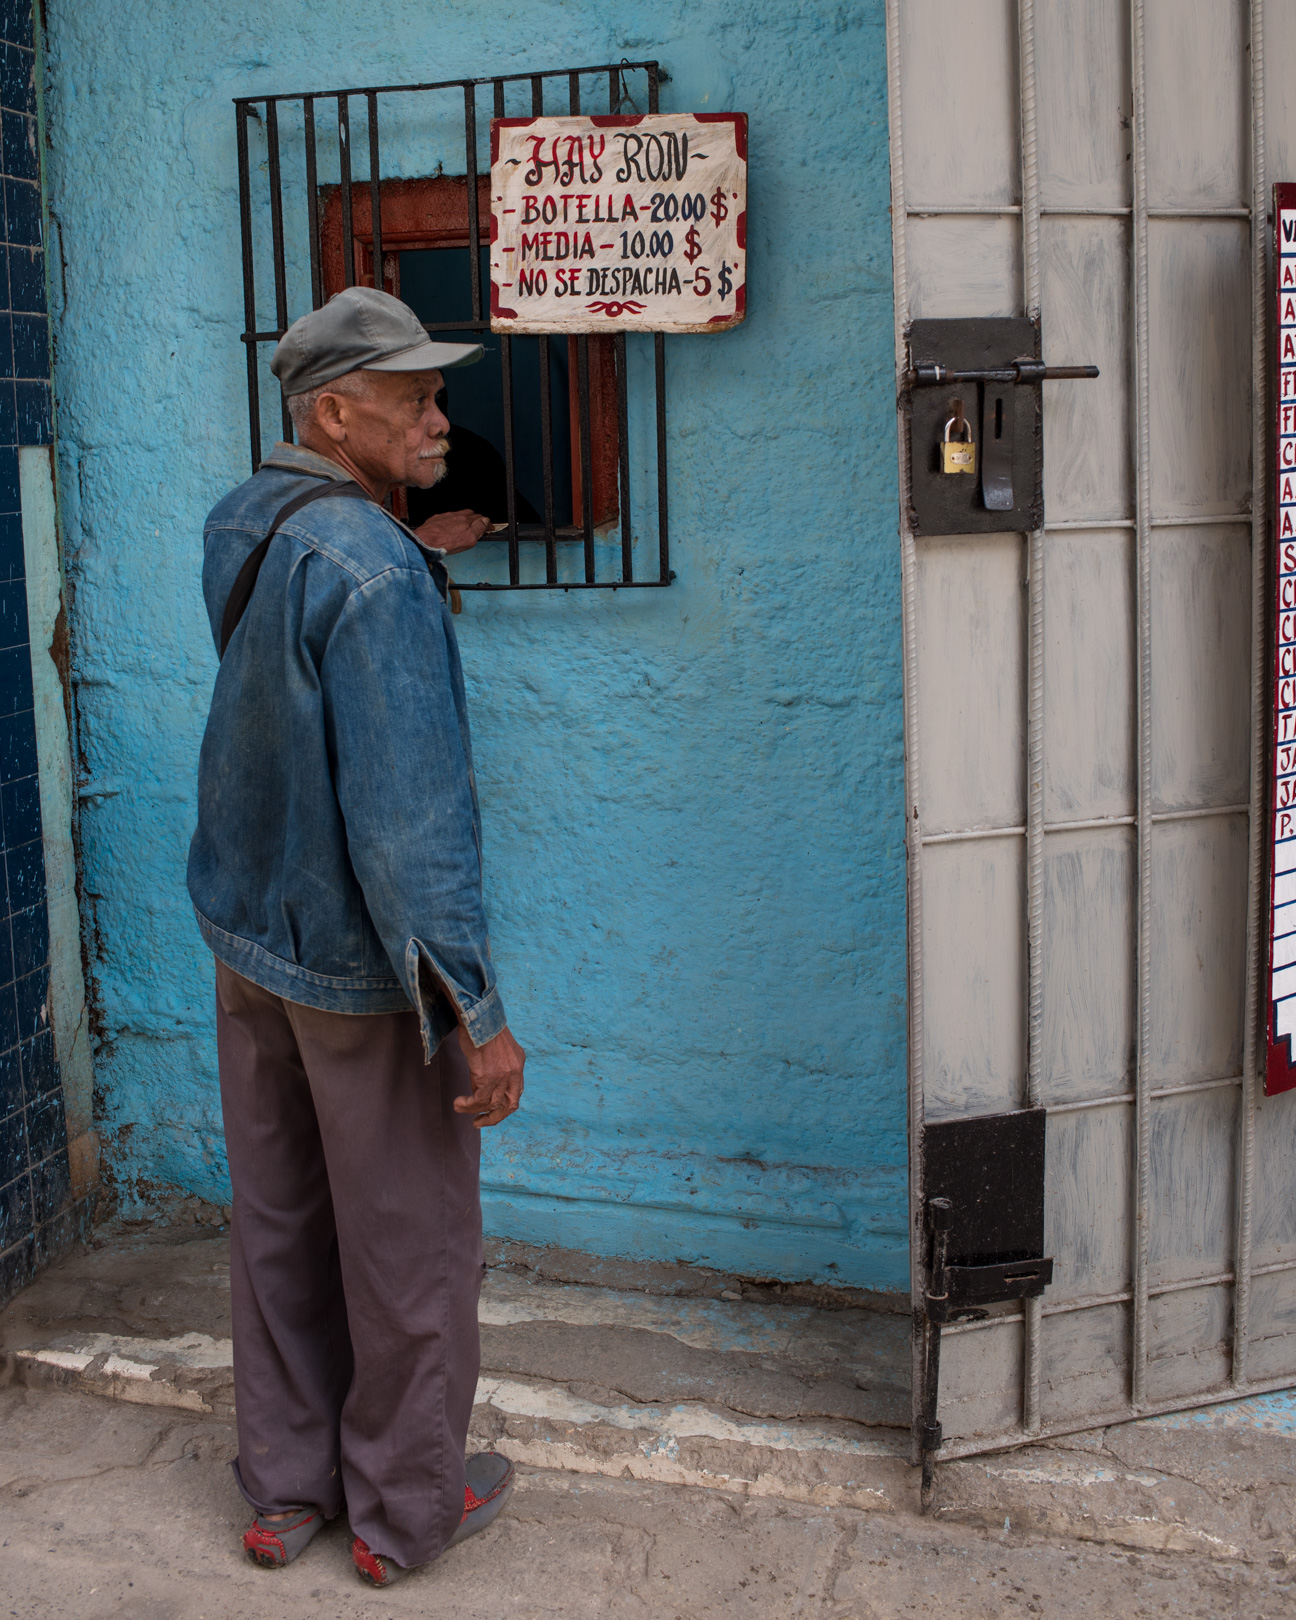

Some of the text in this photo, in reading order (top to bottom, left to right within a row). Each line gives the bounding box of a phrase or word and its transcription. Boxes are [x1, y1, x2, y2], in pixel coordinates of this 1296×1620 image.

[521, 231, 595, 261] MEDIA
[620, 230, 673, 259] 10.00
[518, 268, 547, 297] NO
[555, 268, 582, 298] SE
